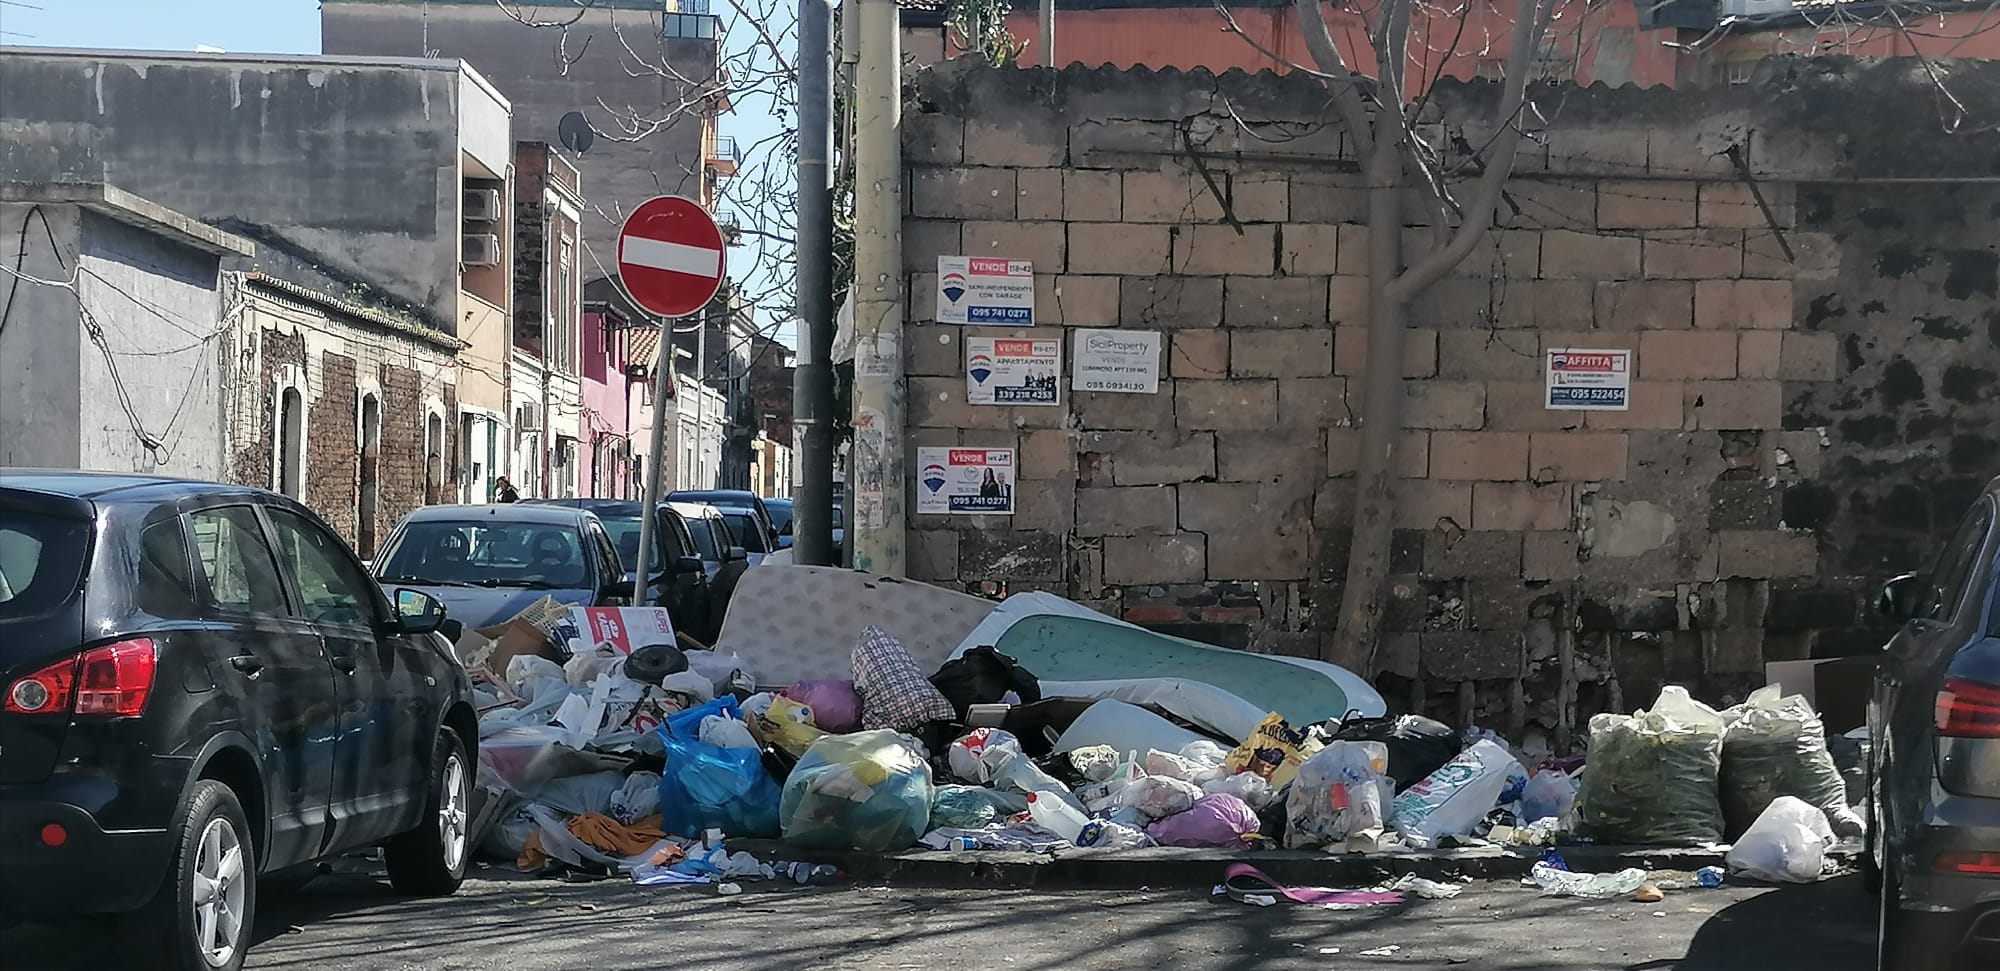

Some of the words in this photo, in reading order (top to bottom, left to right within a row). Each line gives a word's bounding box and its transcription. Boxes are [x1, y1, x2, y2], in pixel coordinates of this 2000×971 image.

[972, 261, 1006, 272] VENDE
[972, 308, 990, 317] 095
[992, 308, 1006, 317] 741
[1007, 309, 1029, 318] 0271
[998, 343, 1030, 353] VENDE
[997, 358, 1055, 366] APPARTAMENTO
[1567, 356, 1610, 368] AFFITTA
[1571, 388, 1590, 399] 095
[953, 453, 983, 463] VENDE
[953, 497, 969, 505] 095
[971, 497, 986, 505] 741
[986, 497, 1007, 505] 0271
[654, 609, 669, 633] SUPER
